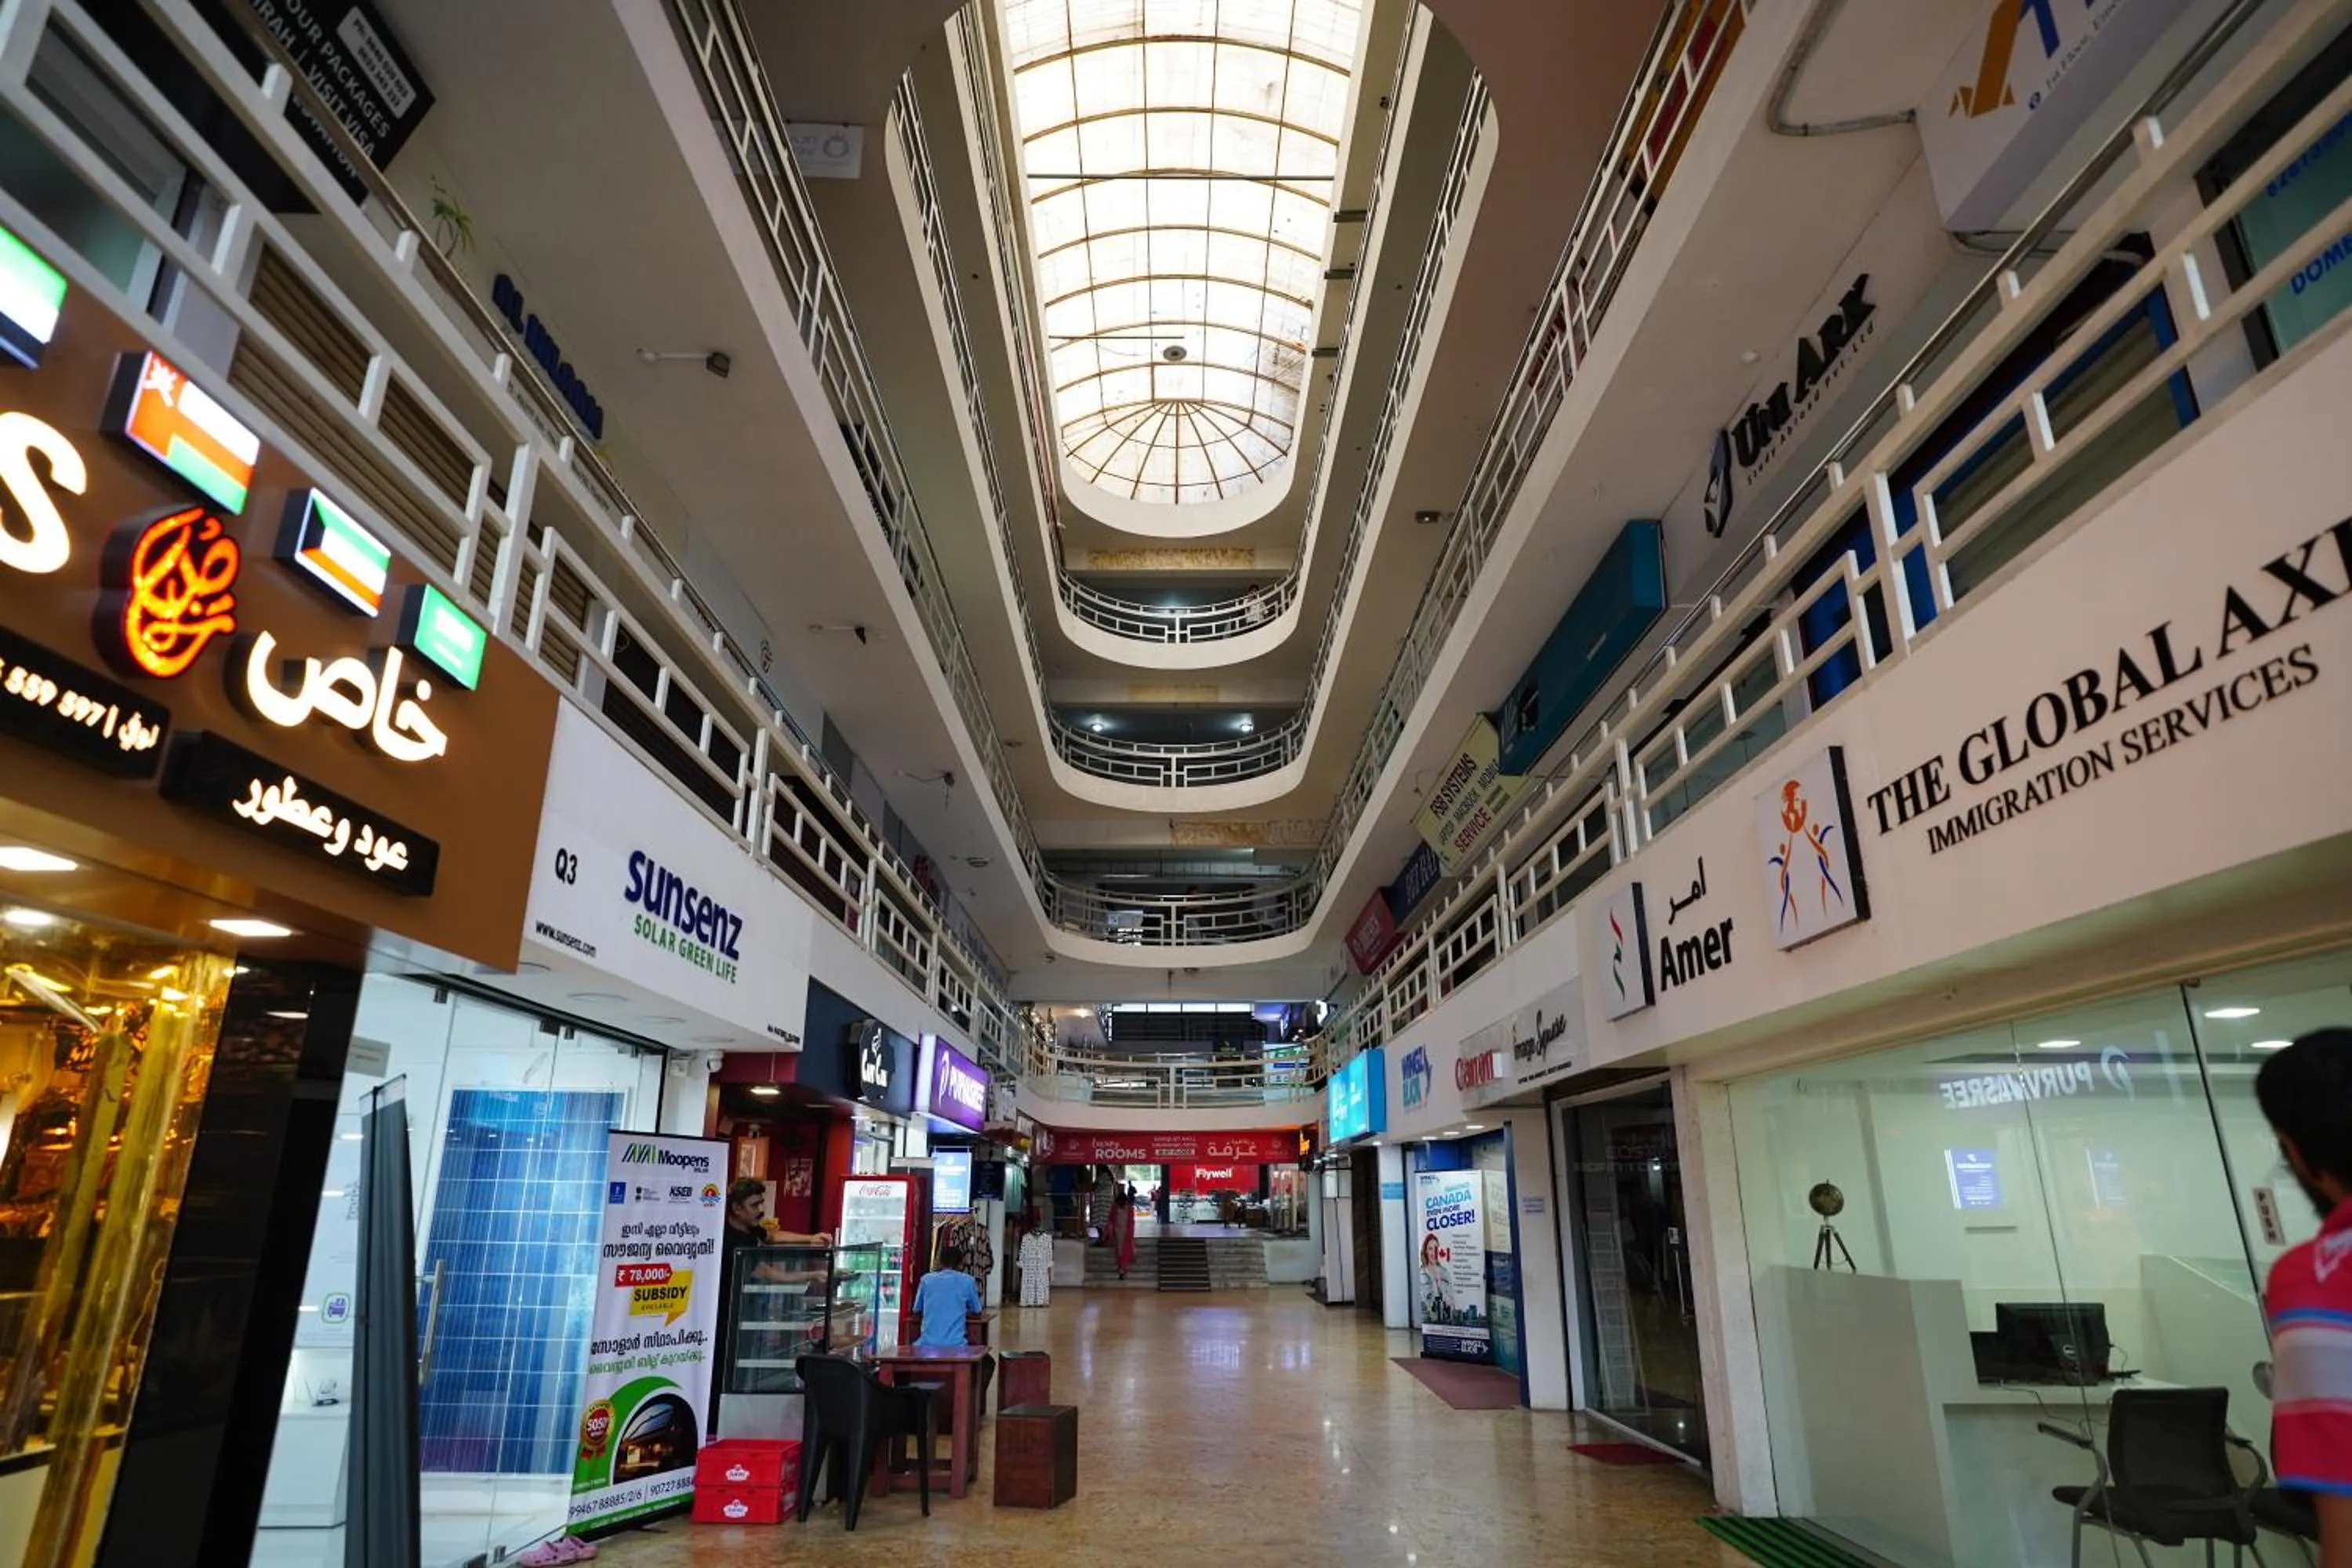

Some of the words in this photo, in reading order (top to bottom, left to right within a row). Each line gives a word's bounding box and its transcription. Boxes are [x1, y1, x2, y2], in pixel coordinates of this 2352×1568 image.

[308, 64, 347, 118] VISIT
[345, 114, 376, 157] VISA
[320, 42, 390, 139] PACKAGES
[246, 630, 448, 763] خاص
[1867, 756, 1951, 836] THE
[1958, 619, 2203, 786] GLOBAL
[1926, 741, 2115, 855] IMMIGRATION
[2119, 644, 2321, 765] SERVICES
[1440, 752, 1477, 803] SYSTEMS
[1454, 807, 1492, 854] SERVICE
[554, 848, 578, 886] Q3
[633, 914, 677, 952] SOLAR
[678, 938, 713, 974] GREEN
[715, 959, 738, 985] LIFE
[1659, 916, 1733, 992] Amer
[658, 1148, 710, 1171] Moopens
[1095, 1149, 1147, 1160] ROOMS
[1195, 1167, 1233, 1181] Flywell
[858, 1184, 892, 1197] Coca-Cola
[1425, 1189, 1472, 1209] CANADA
[1426, 1208, 1475, 1232] CLOSER!
[633, 1285, 688, 1302] SUBSIDY
